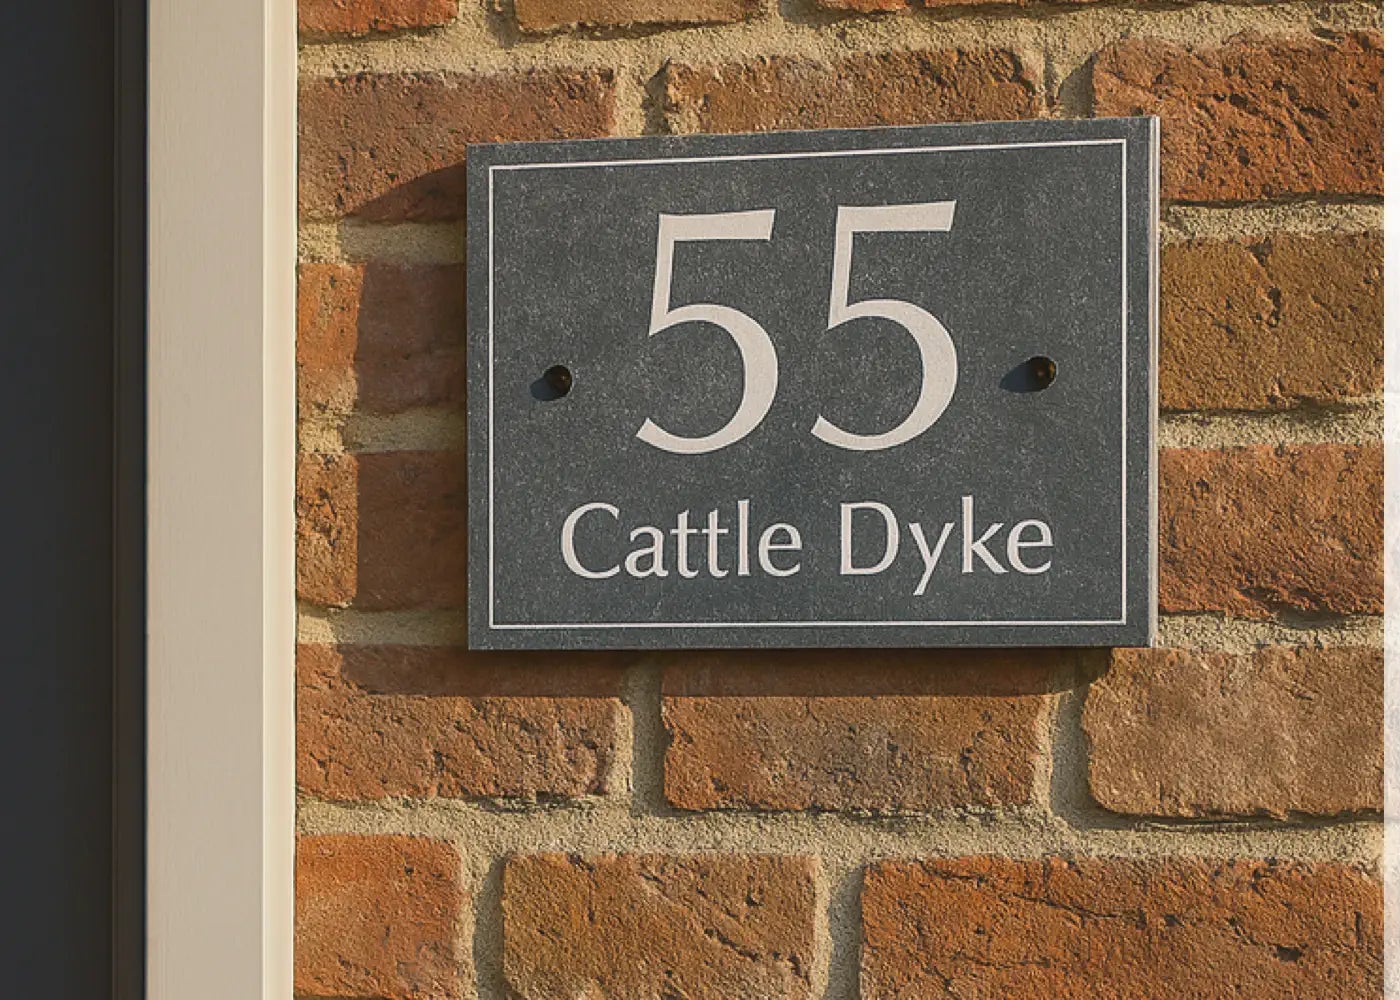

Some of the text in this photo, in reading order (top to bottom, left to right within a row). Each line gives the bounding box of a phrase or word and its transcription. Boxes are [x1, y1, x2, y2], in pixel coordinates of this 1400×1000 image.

[635, 199, 959, 455] 55
[560, 494, 1054, 597] Cattle Dyke
